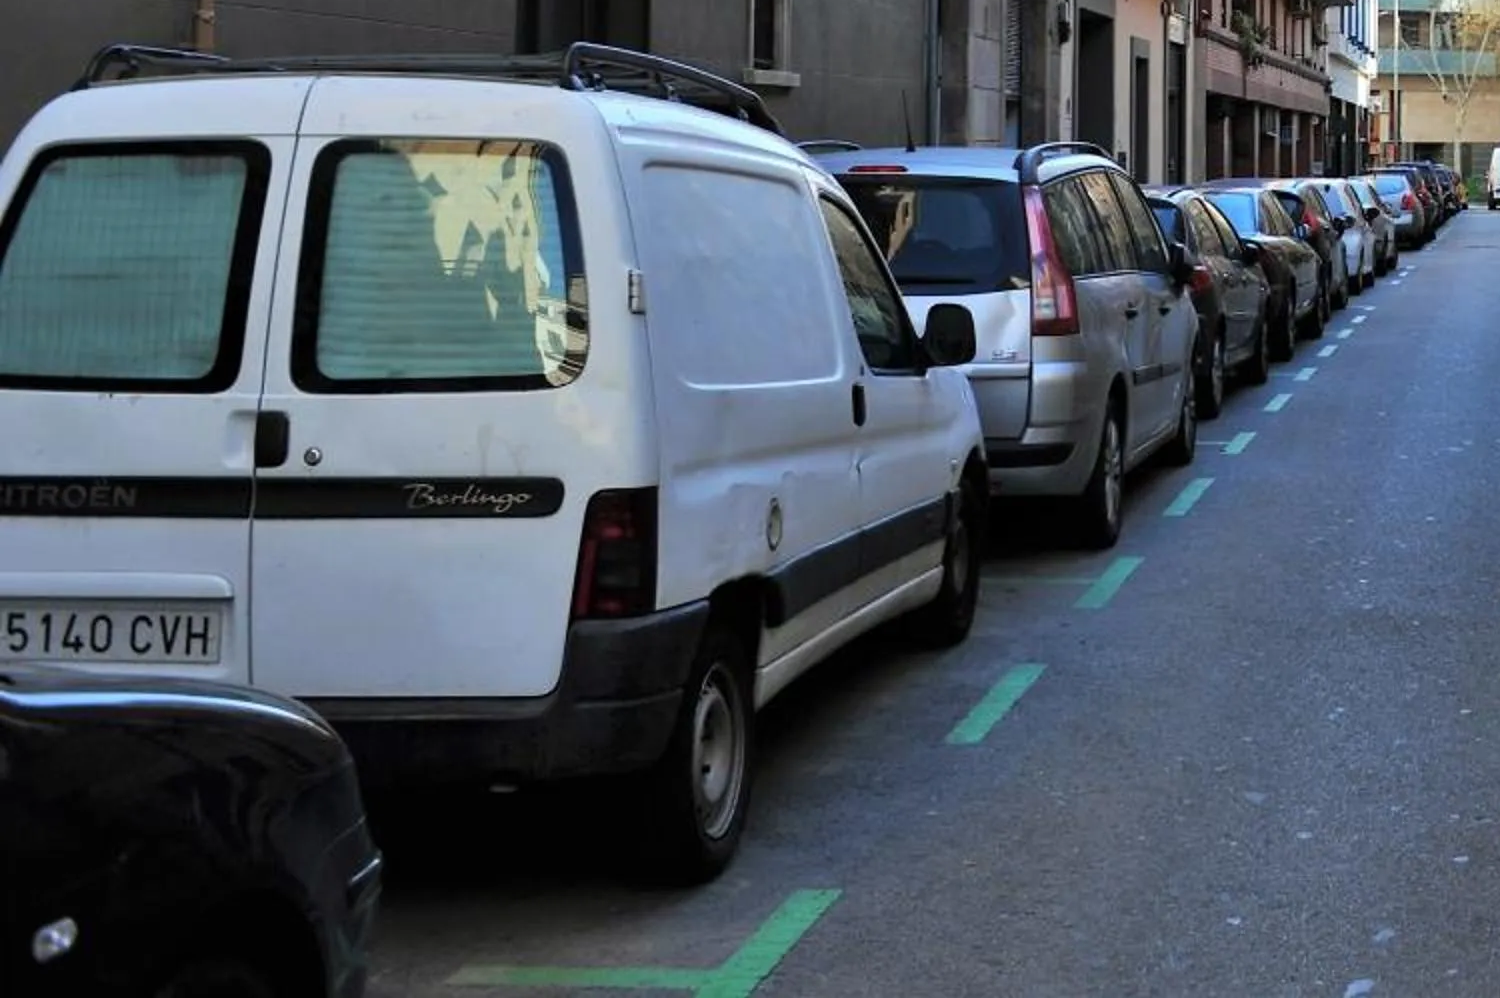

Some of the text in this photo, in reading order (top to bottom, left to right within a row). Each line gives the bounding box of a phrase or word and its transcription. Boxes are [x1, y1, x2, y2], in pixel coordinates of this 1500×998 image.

[0, 477, 137, 508] ITROËN
[403, 483, 532, 513] Berlingo
[6, 612, 211, 657] 5140 CVH
